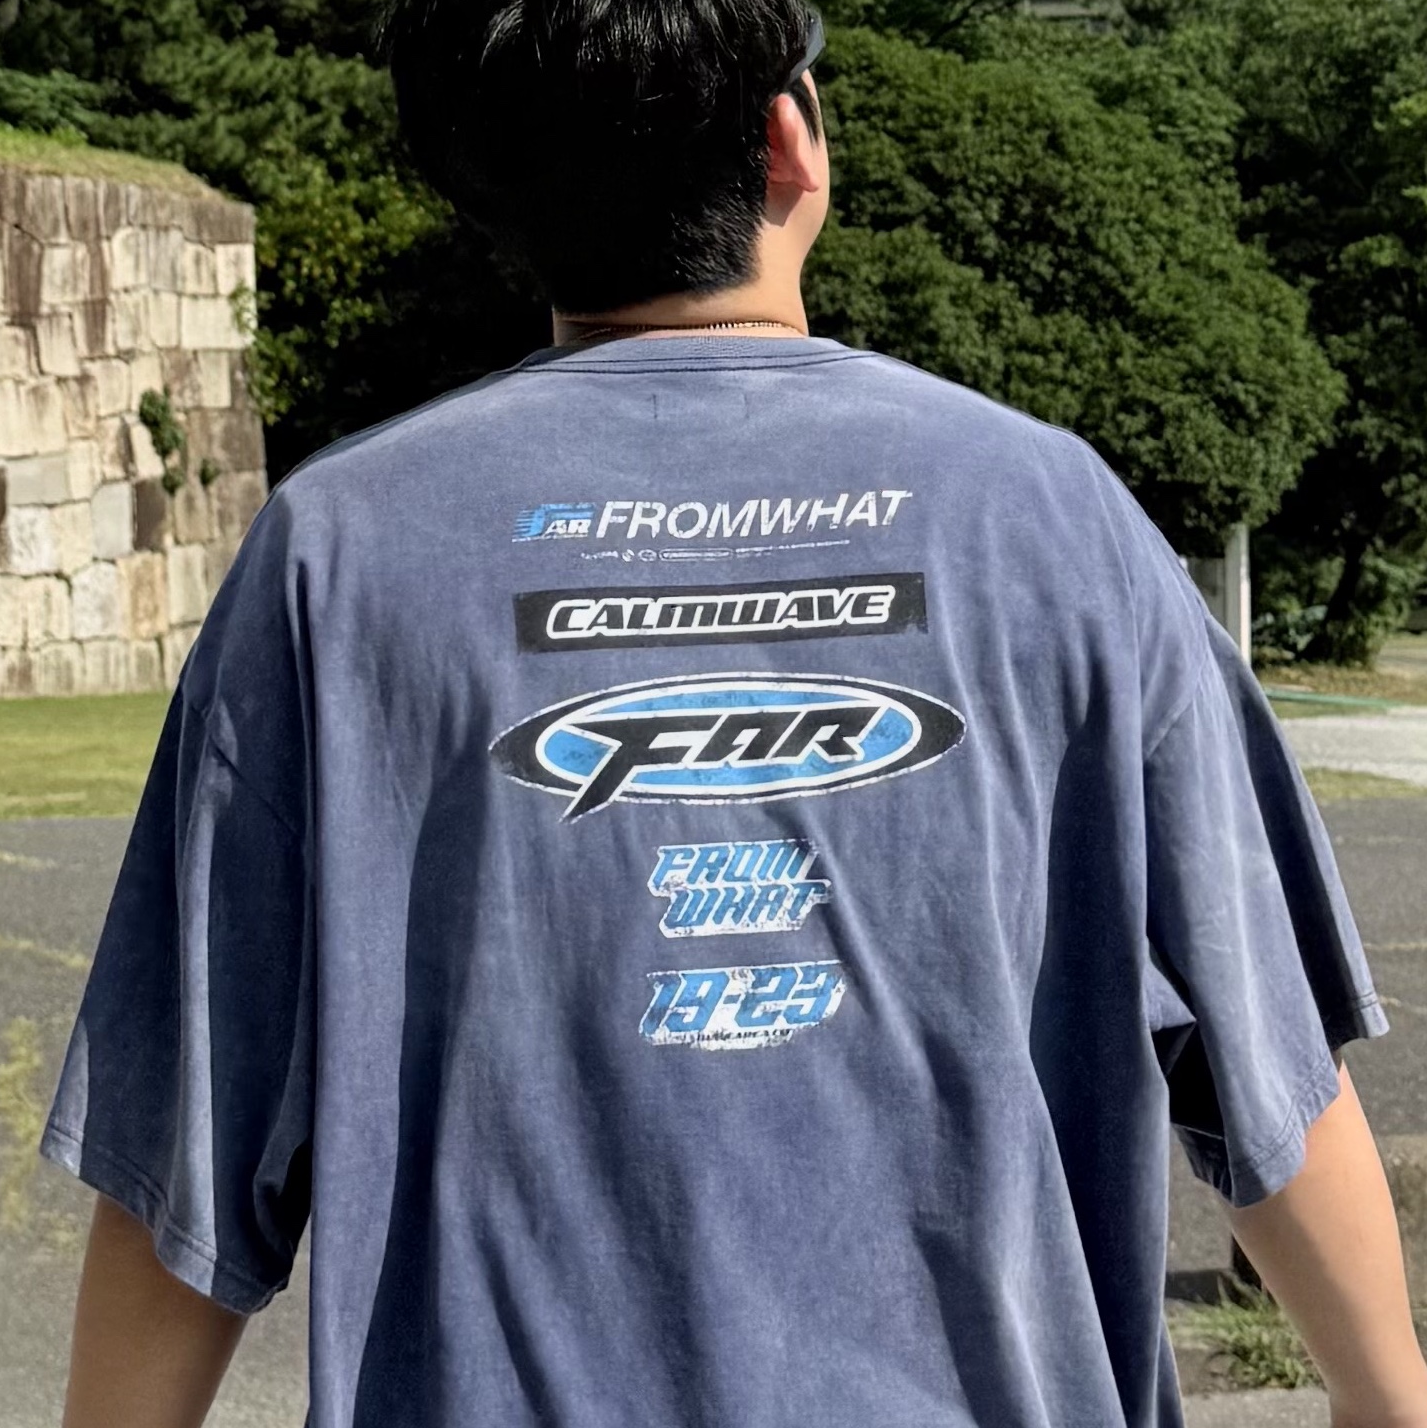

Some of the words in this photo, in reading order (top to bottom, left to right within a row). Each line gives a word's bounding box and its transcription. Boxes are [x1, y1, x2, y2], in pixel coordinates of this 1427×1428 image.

[596, 490, 912, 539] FROMWHAT
[548, 586, 894, 638] CALMWAVE
[561, 705, 881, 823] FAR
[651, 842, 814, 889] FROM
[664, 880, 828, 929] WHAT
[642, 964, 840, 1036] 19-23
